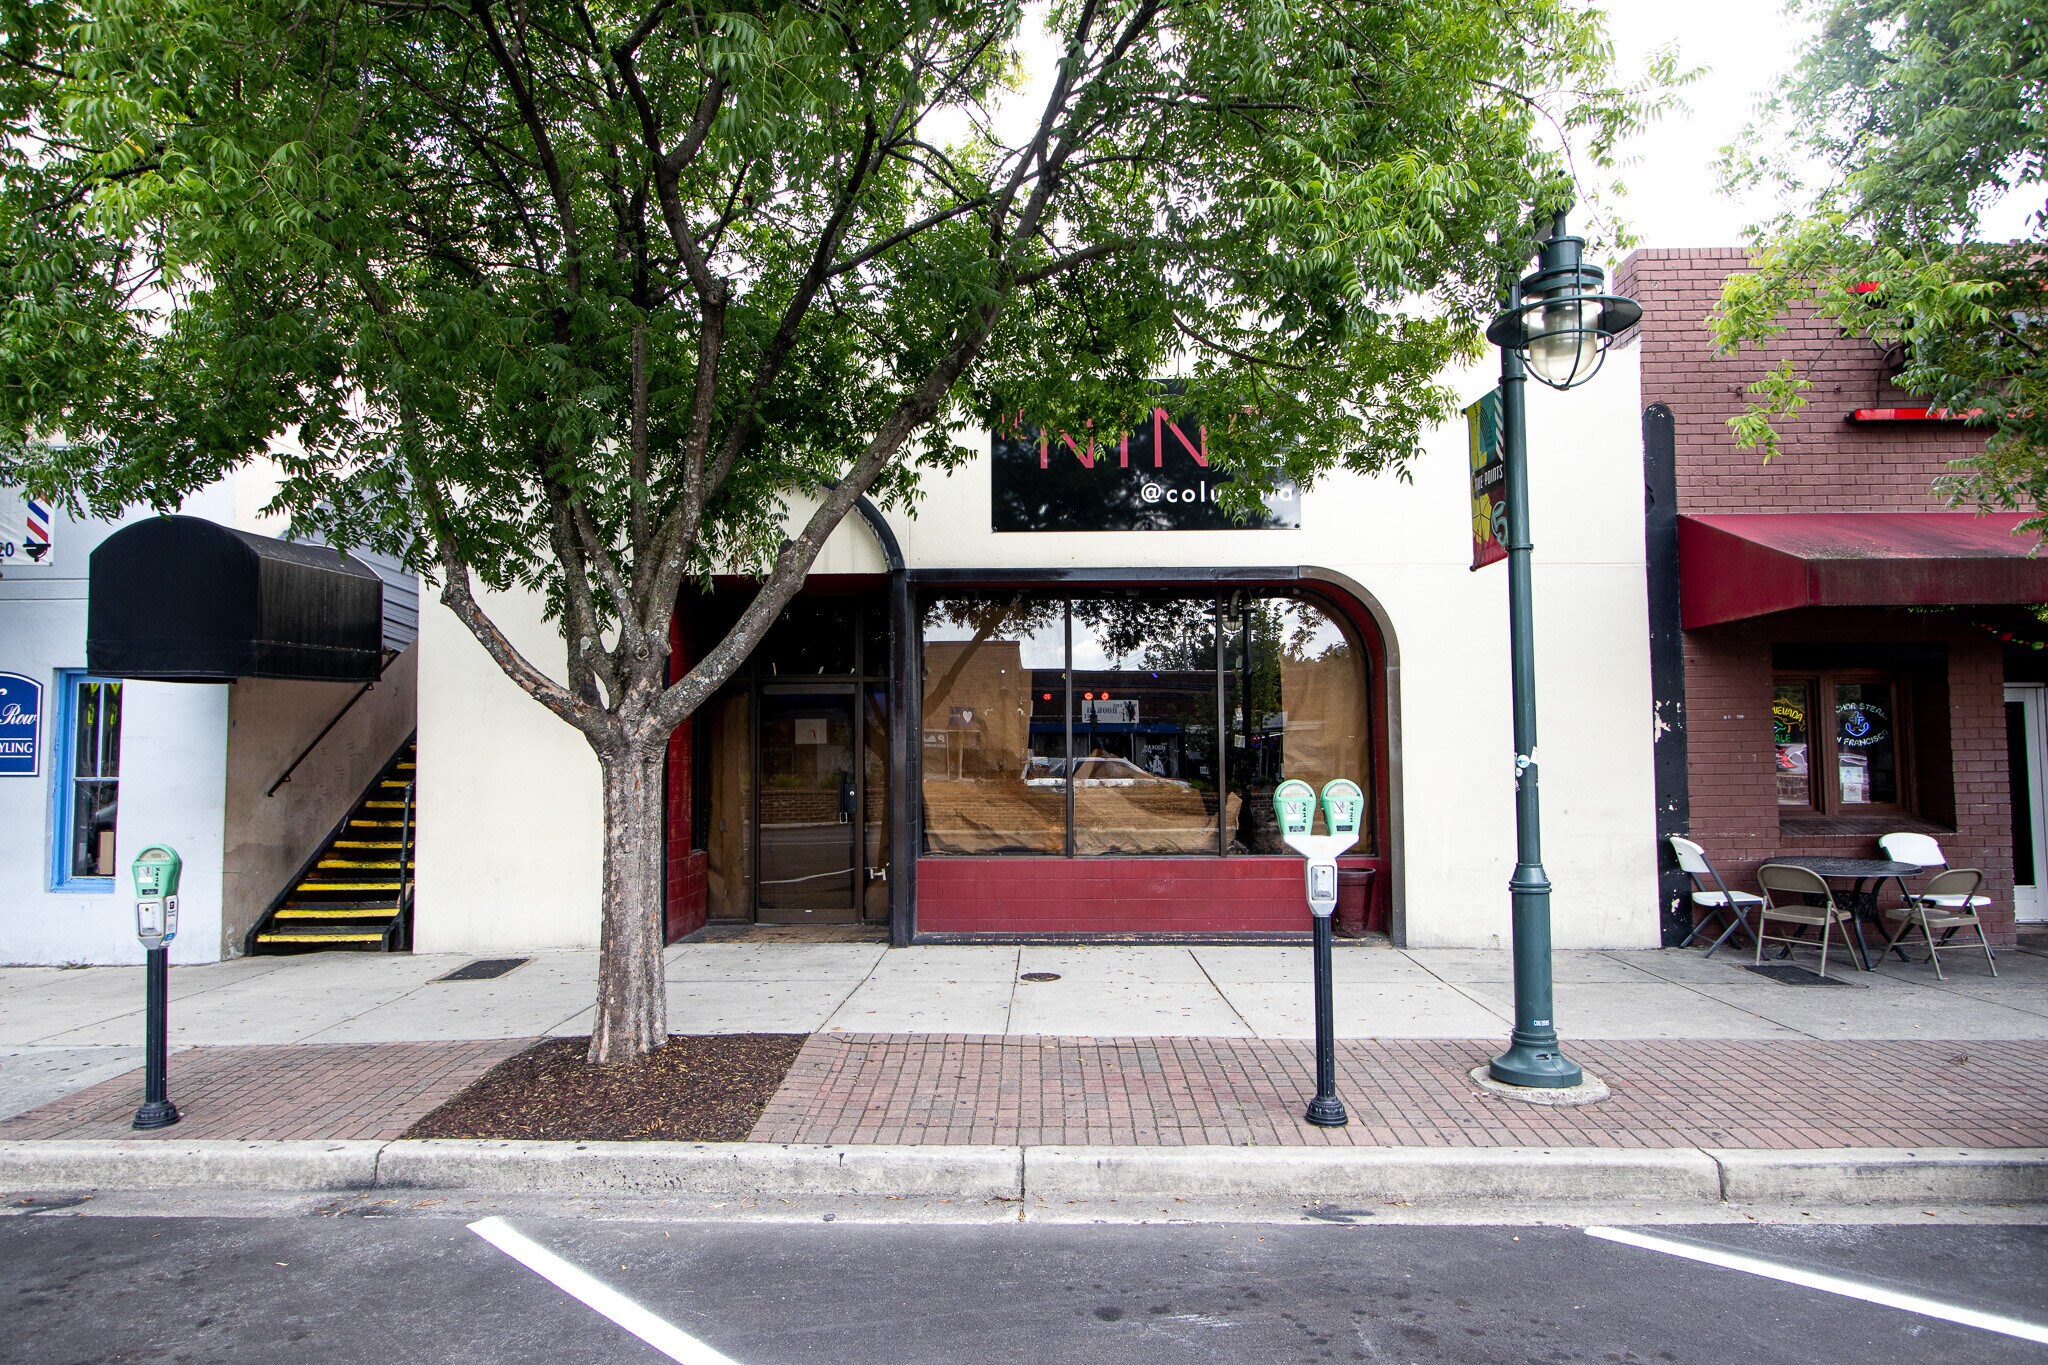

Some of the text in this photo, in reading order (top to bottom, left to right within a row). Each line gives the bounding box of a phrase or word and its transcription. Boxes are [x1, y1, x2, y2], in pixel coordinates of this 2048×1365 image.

[1040, 406, 1262, 469] NIN
[1484, 464, 1503, 485] POINTS
[0, 703, 37, 725] Row
[1774, 733, 1791, 743] ALE
[1843, 729, 1888, 747] FRANCISCO
